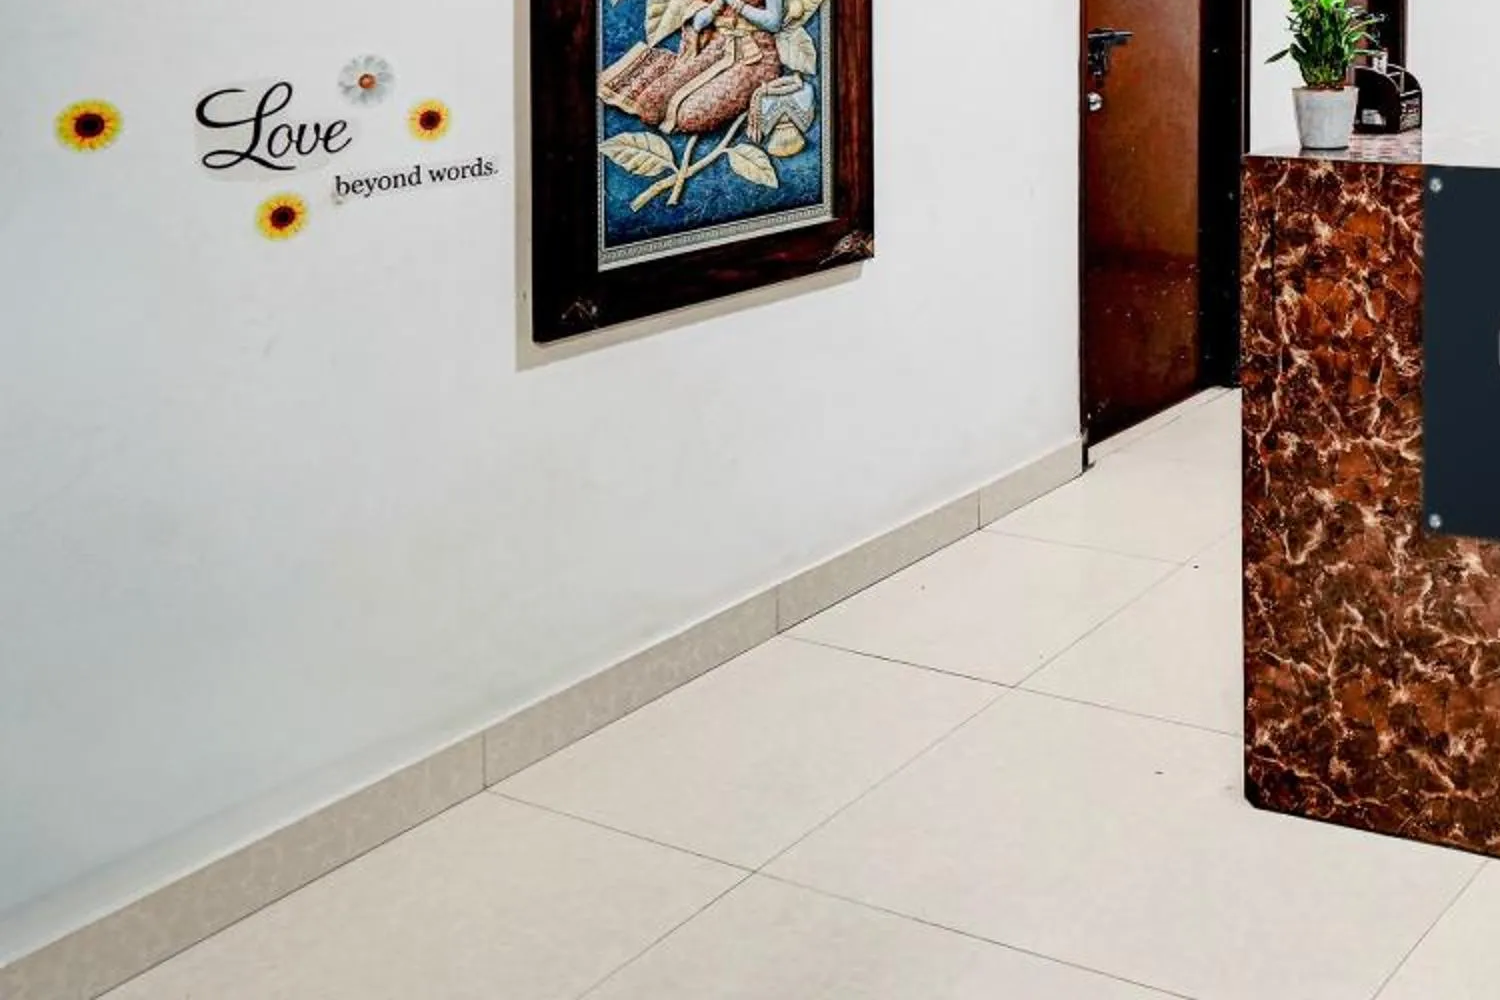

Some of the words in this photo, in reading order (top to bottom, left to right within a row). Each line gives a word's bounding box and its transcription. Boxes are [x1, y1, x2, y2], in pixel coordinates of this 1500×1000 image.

[195, 81, 353, 171] Love
[335, 164, 422, 197] beyond
[427, 156, 499, 182] words.
